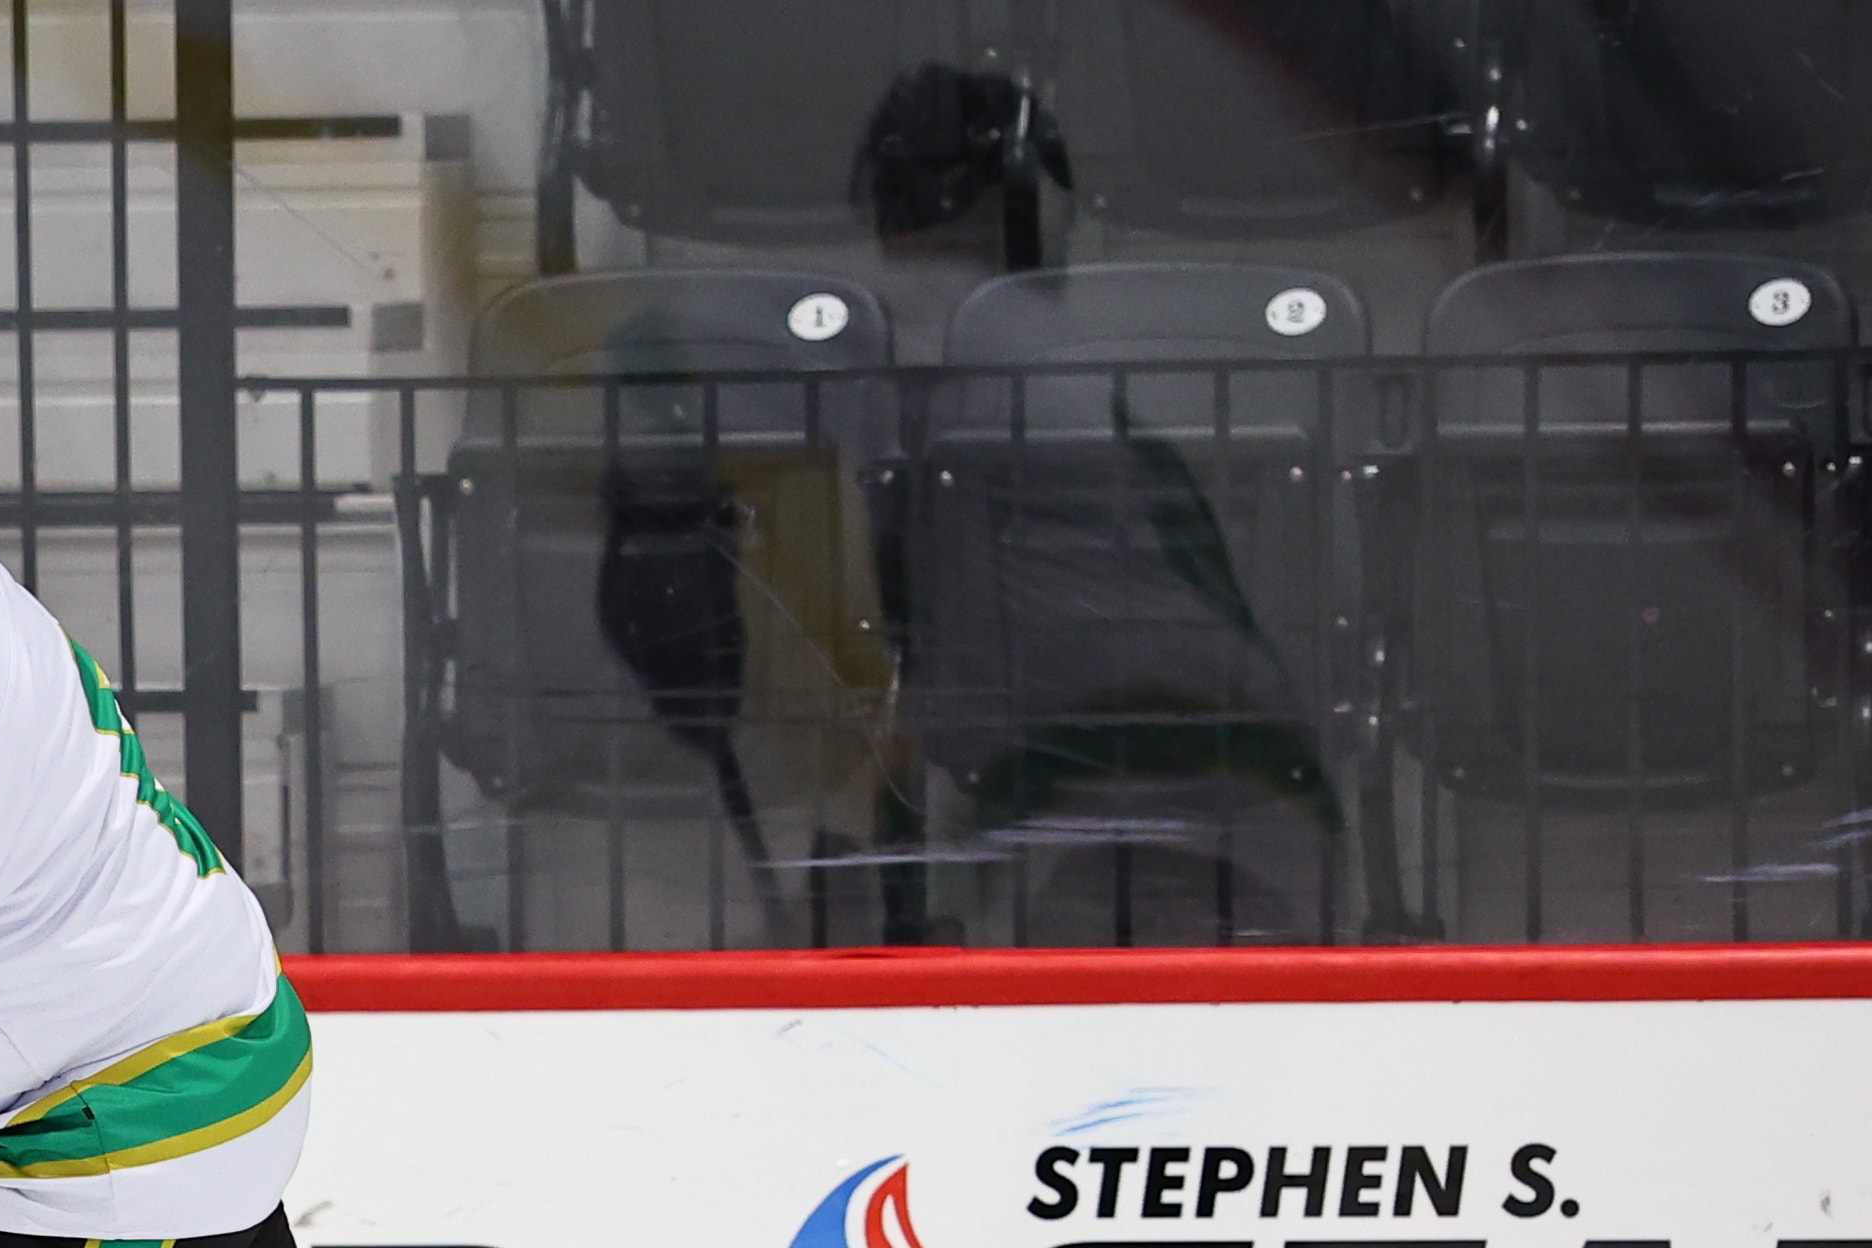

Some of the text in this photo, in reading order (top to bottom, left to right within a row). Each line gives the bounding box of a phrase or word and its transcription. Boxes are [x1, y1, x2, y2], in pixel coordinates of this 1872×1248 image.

[1287, 300, 1305, 324] 2
[1771, 289, 1790, 315] 3
[813, 303, 827, 328] 1
[1027, 1143, 1580, 1220] STEPHEN S.
